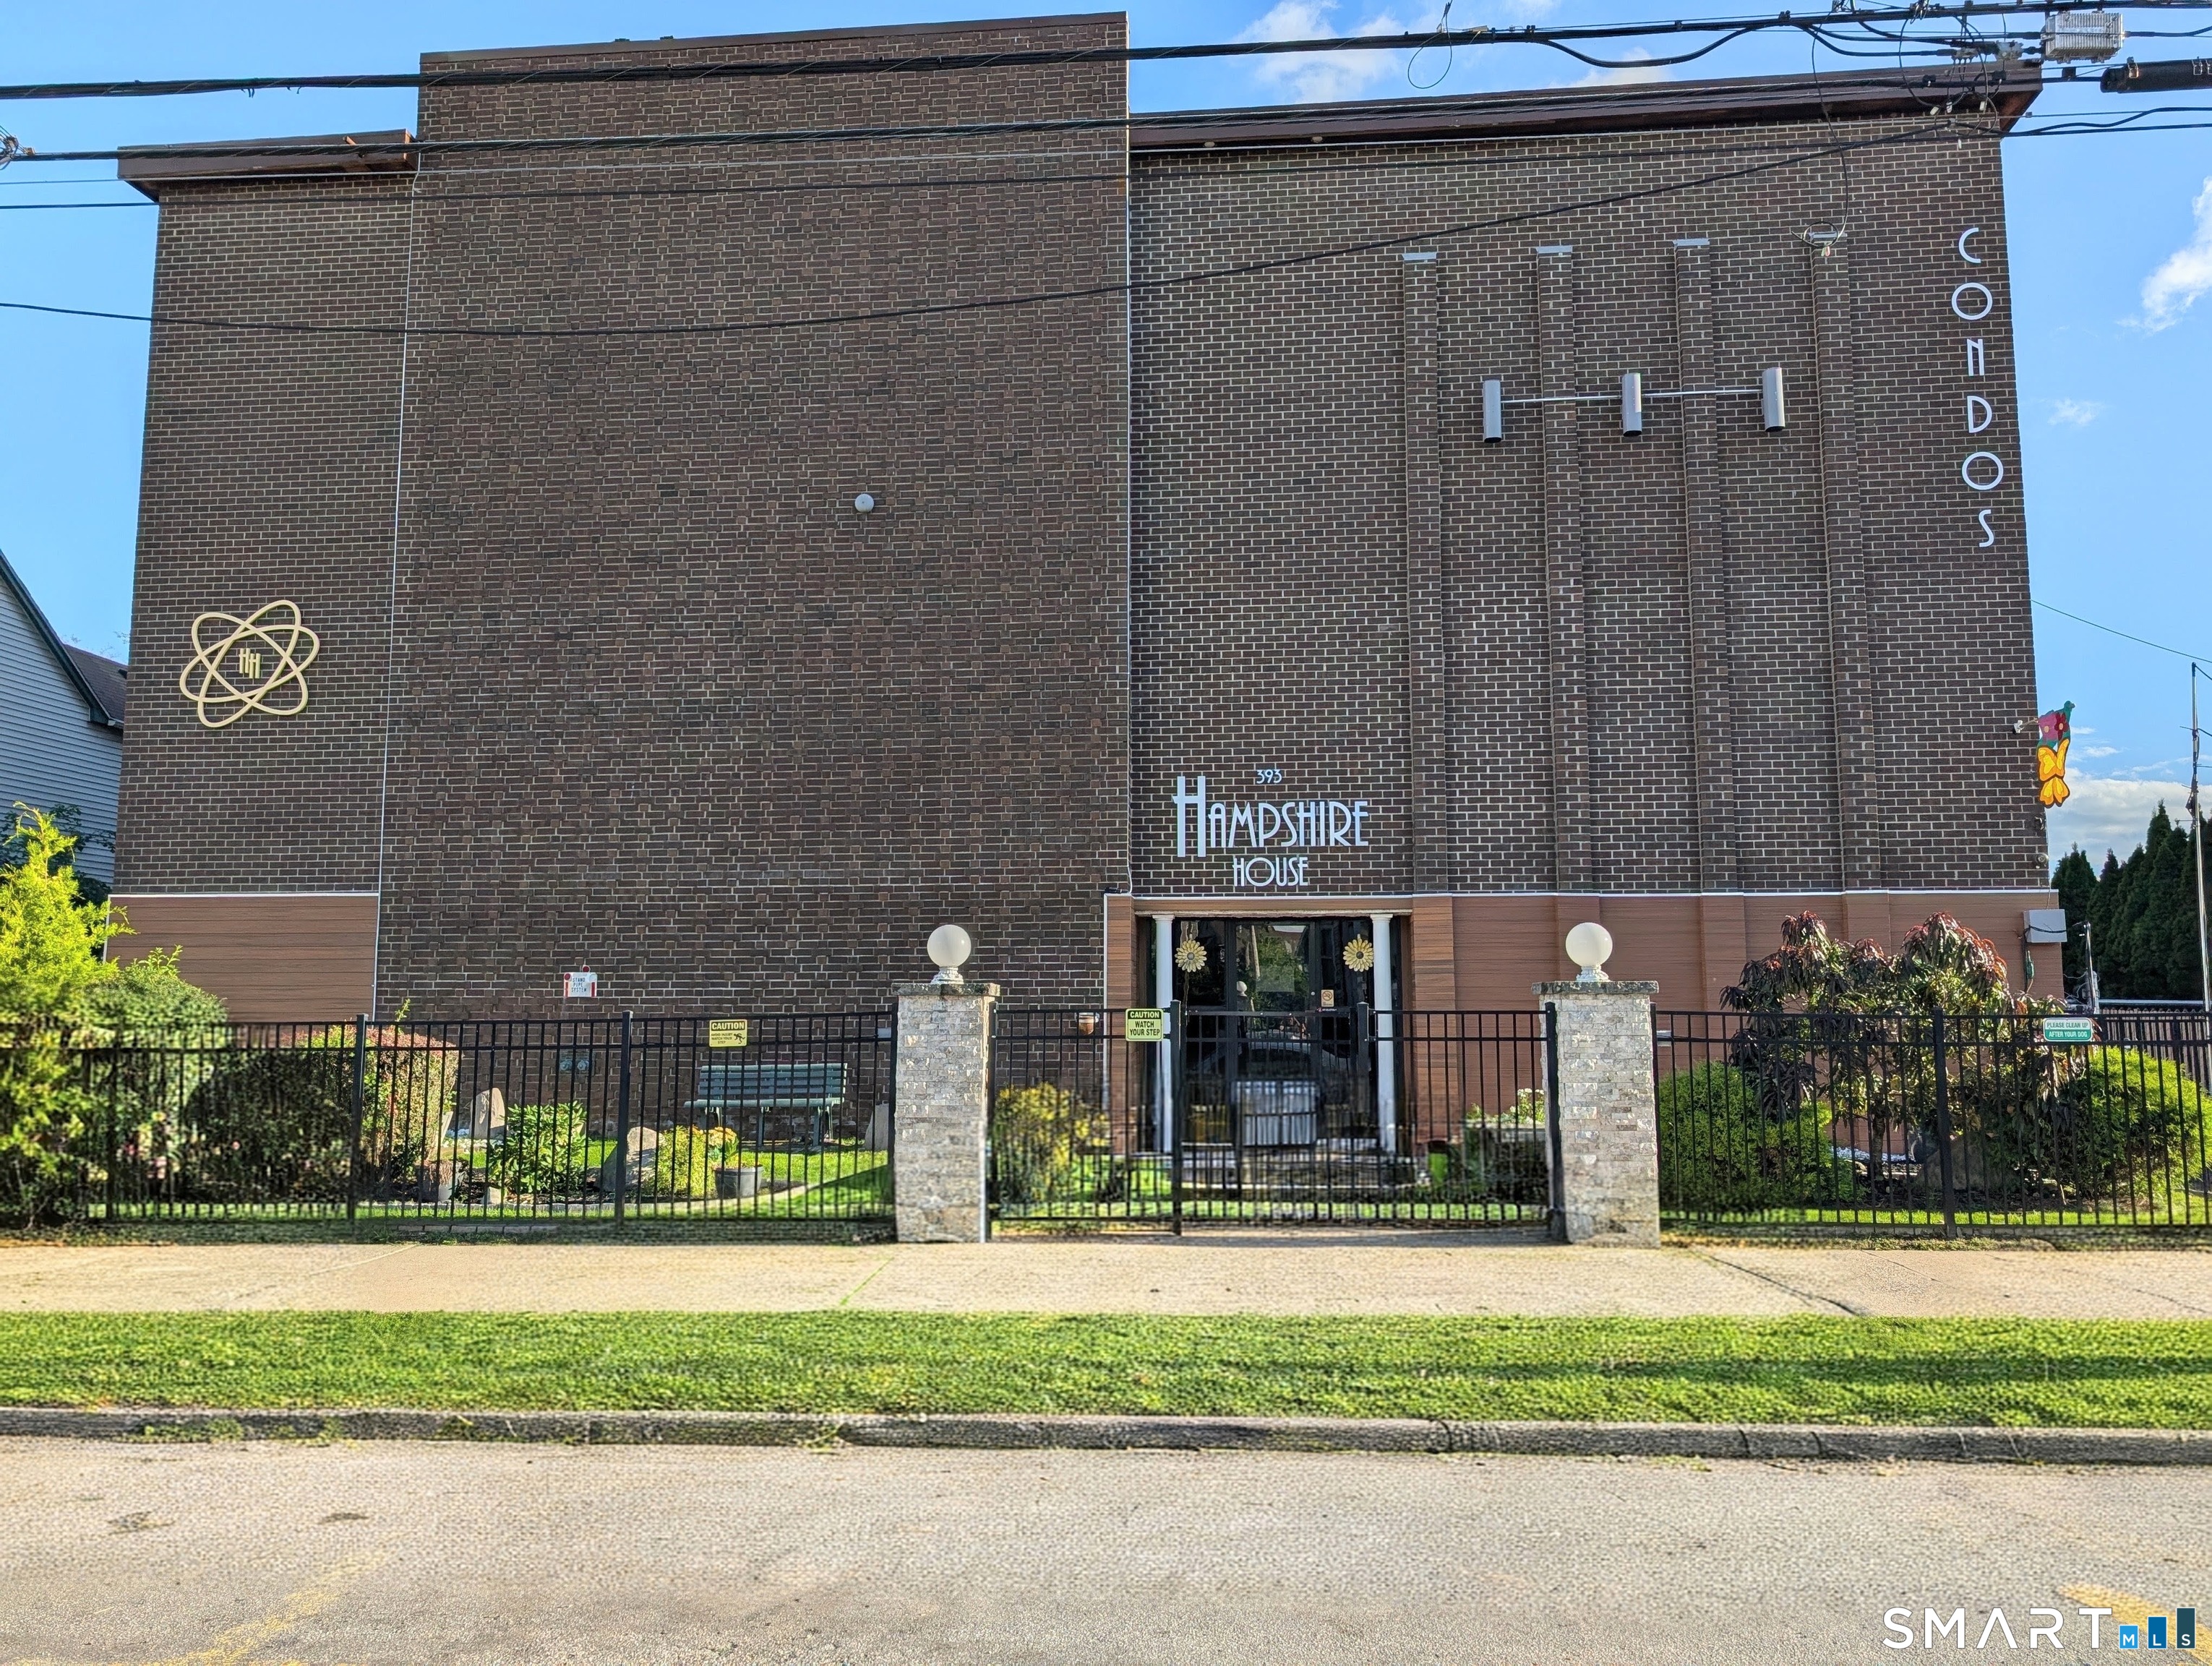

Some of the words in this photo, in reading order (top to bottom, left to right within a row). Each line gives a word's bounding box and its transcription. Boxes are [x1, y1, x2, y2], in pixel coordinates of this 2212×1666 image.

[1952, 227, 2004, 548] CONDOS
[1256, 769, 1282, 784] 393
[1172, 775, 1369, 858] HAMPSHIRE
[1232, 857, 1308, 887] HOUSE
